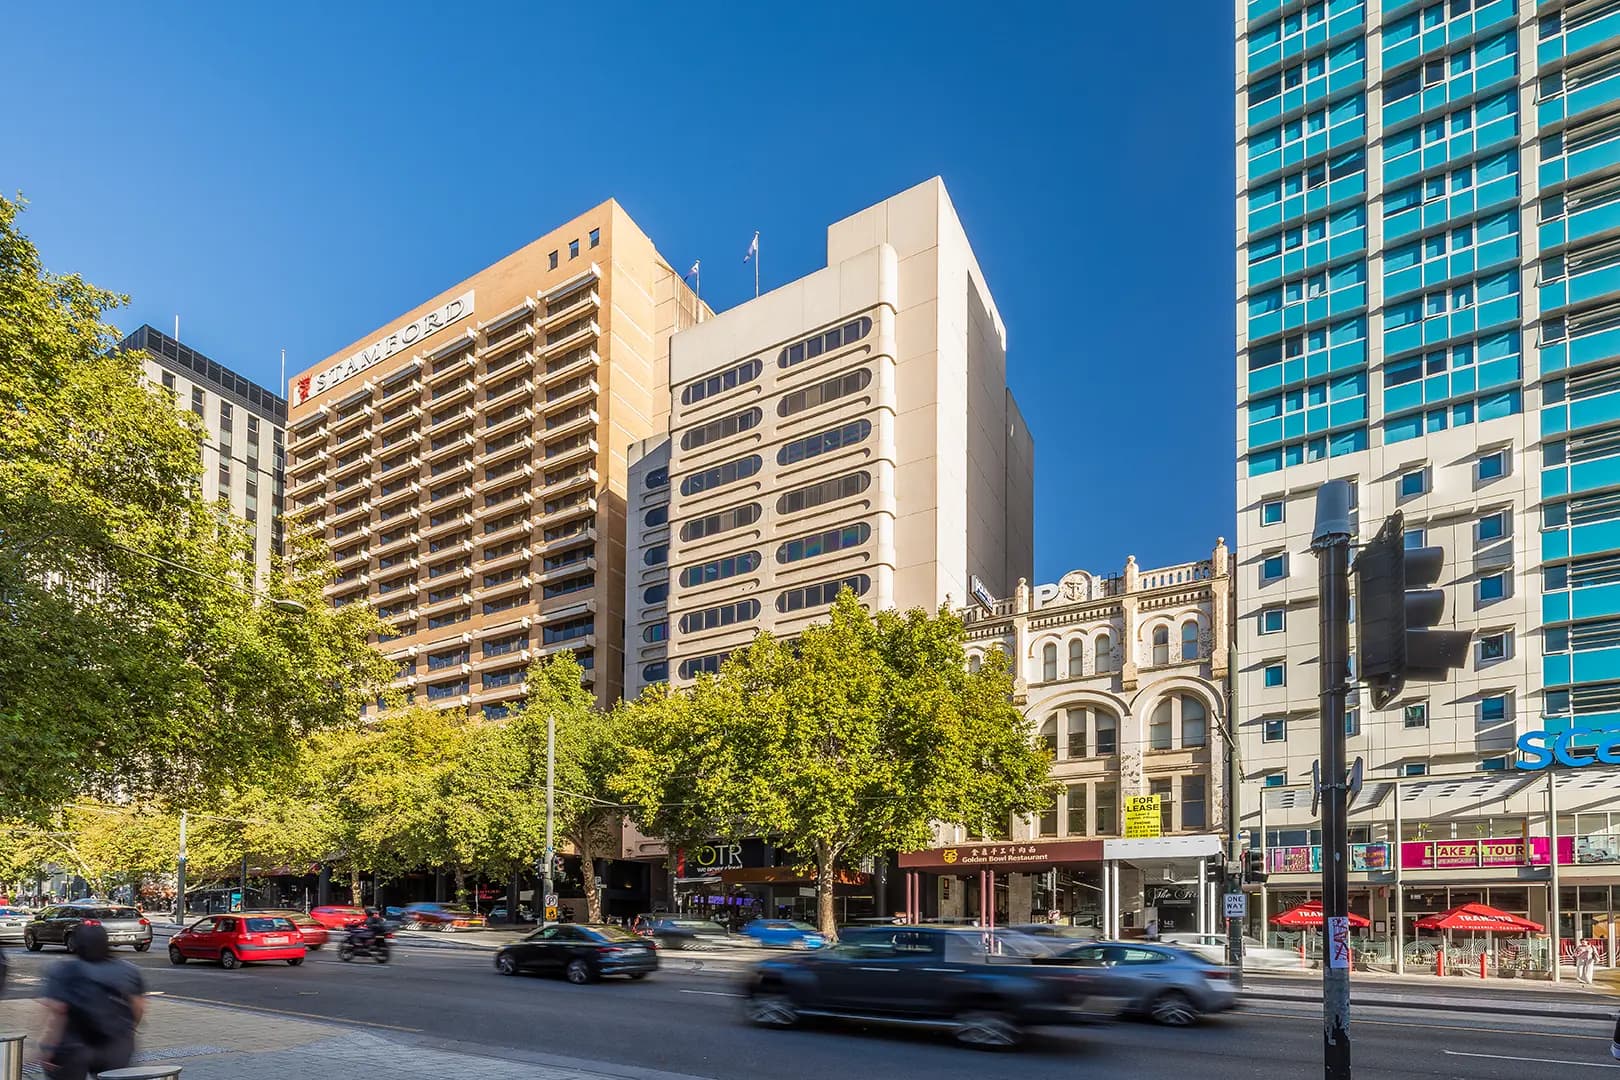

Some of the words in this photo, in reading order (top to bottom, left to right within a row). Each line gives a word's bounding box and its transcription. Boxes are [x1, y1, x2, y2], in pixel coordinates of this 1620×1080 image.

[315, 299, 464, 392] STAMFORD
[1132, 796, 1153, 804] FOR
[1126, 803, 1160, 813] LEASE
[697, 844, 743, 866] OTR
[1427, 846, 1466, 857] TAKE
[1469, 846, 1484, 856] A
[1488, 845, 1525, 855] TOUR
[962, 855, 987, 863] Golden
[989, 854, 1007, 862] Bowl
[1008, 853, 1048, 862] Restaurant
